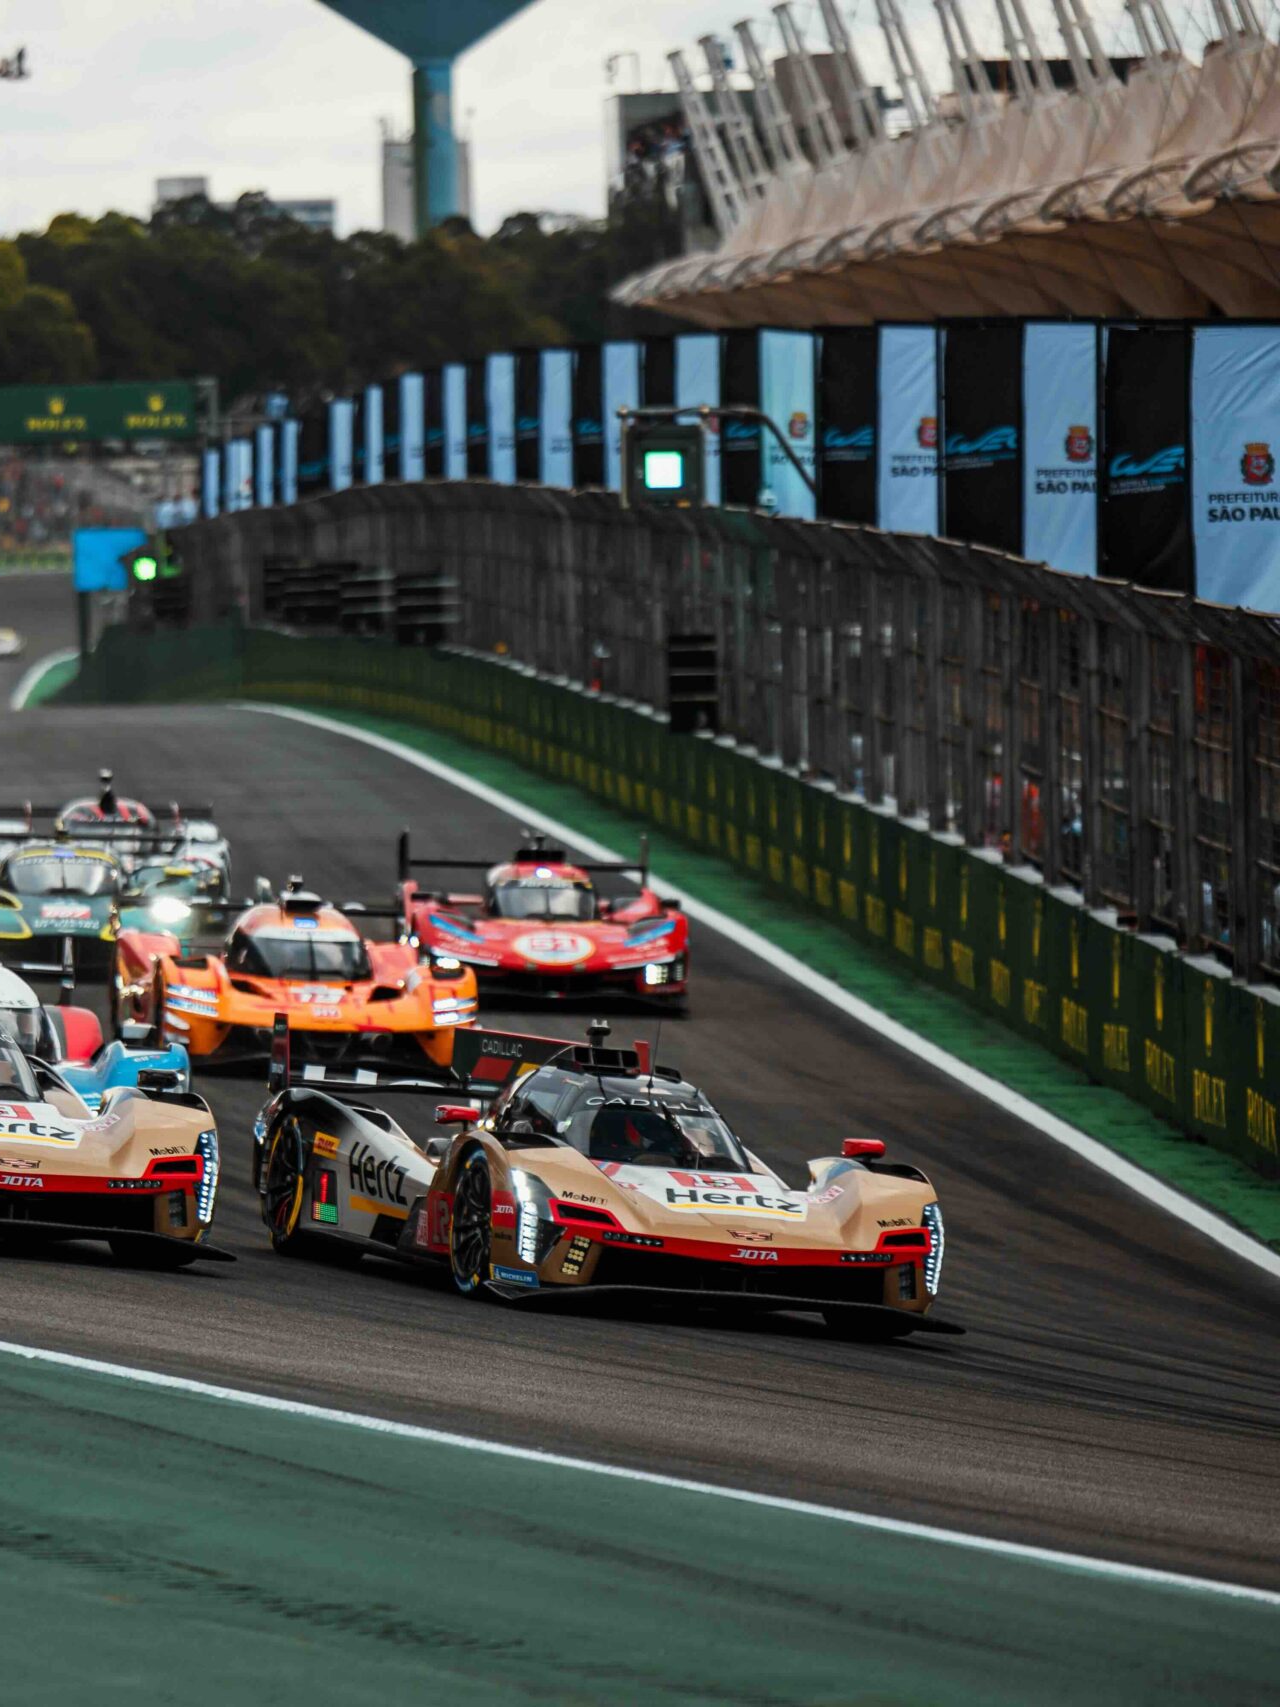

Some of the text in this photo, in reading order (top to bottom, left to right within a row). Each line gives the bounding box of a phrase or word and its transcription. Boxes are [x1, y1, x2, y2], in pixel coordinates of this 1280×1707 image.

[1036, 480, 1068, 495] SÃO
[1208, 506, 1246, 522] SÃO
[481, 1039, 523, 1057] CADILLAC
[349, 1142, 410, 1206] Hertz
[666, 1188, 802, 1214] Hertz
[493, 1204, 514, 1215] JOTA
[729, 1248, 779, 1261] JOTA
[500, 1271, 533, 1283] MICHELIN
